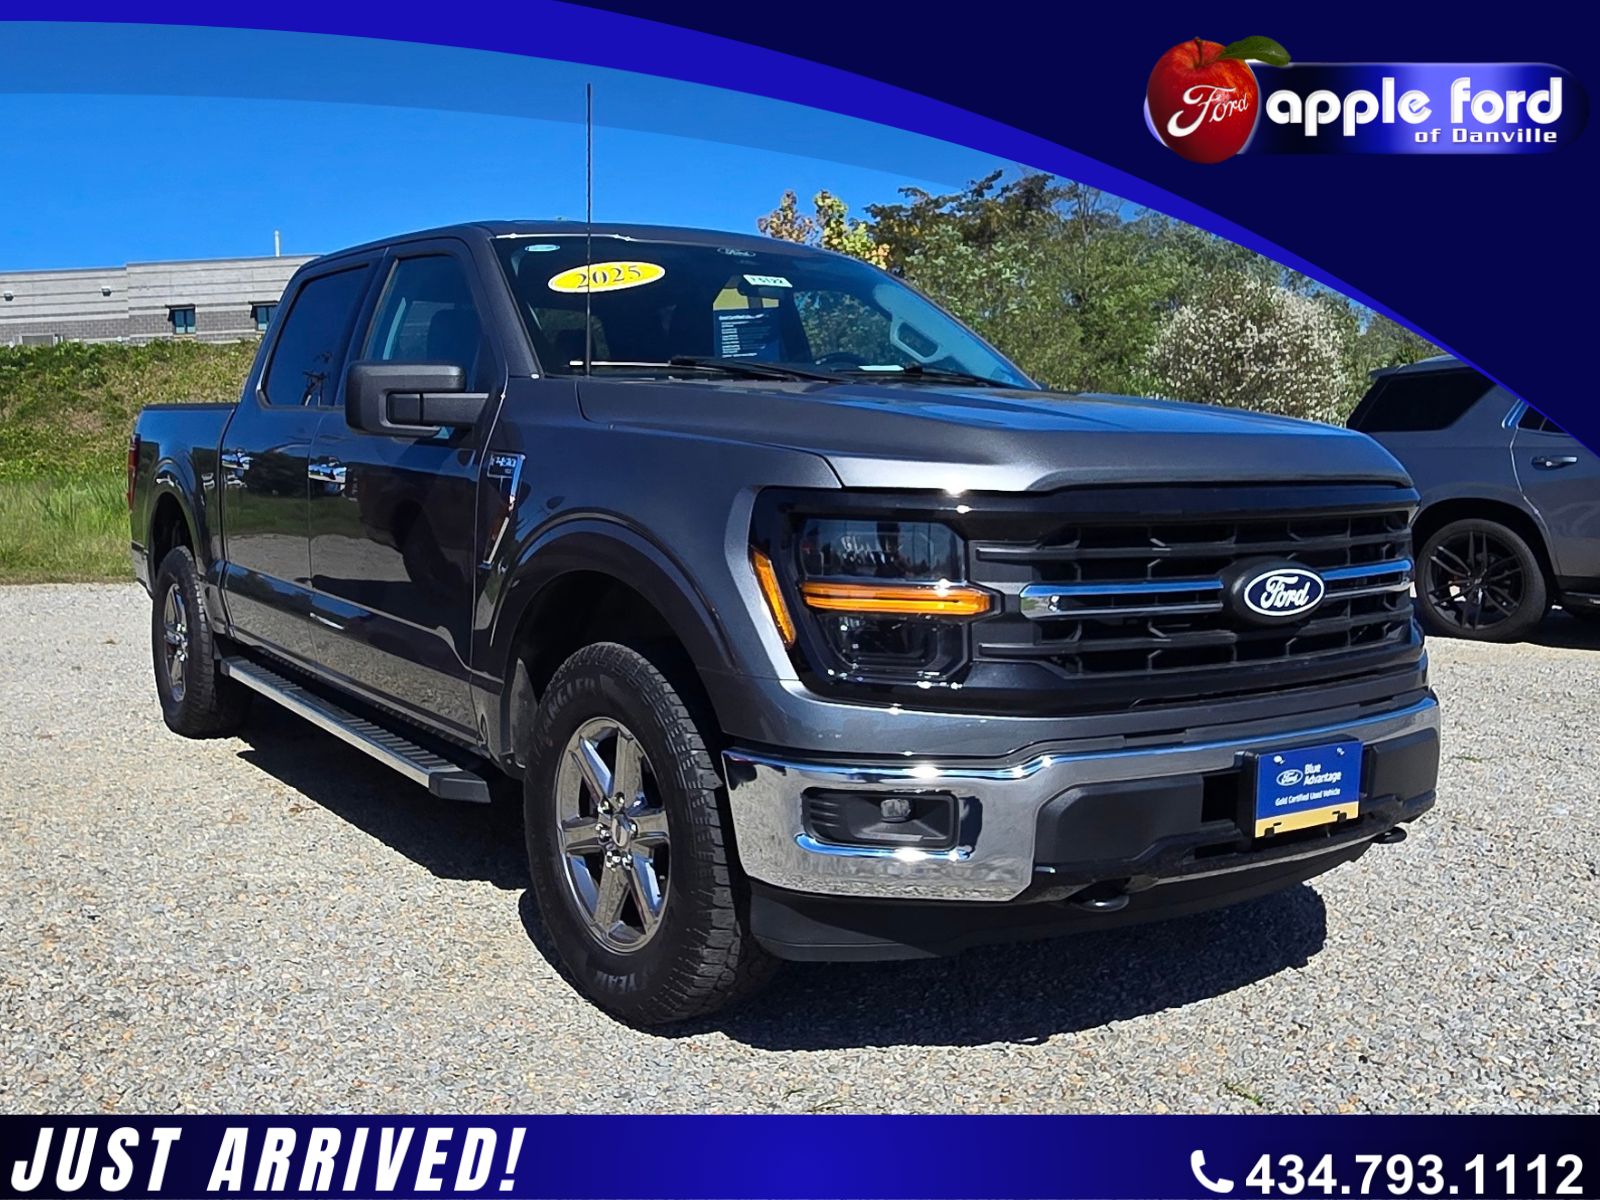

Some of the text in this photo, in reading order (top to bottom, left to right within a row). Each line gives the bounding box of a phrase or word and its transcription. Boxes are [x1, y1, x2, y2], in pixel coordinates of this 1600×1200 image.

[576, 265, 641, 289] 2025
[1260, 575, 1311, 609] Ford
[1304, 763, 1322, 774] Blue
[1303, 771, 1342, 787] Advantage
[1275, 788, 1341, 806] Gold Certified Used Vehicle
